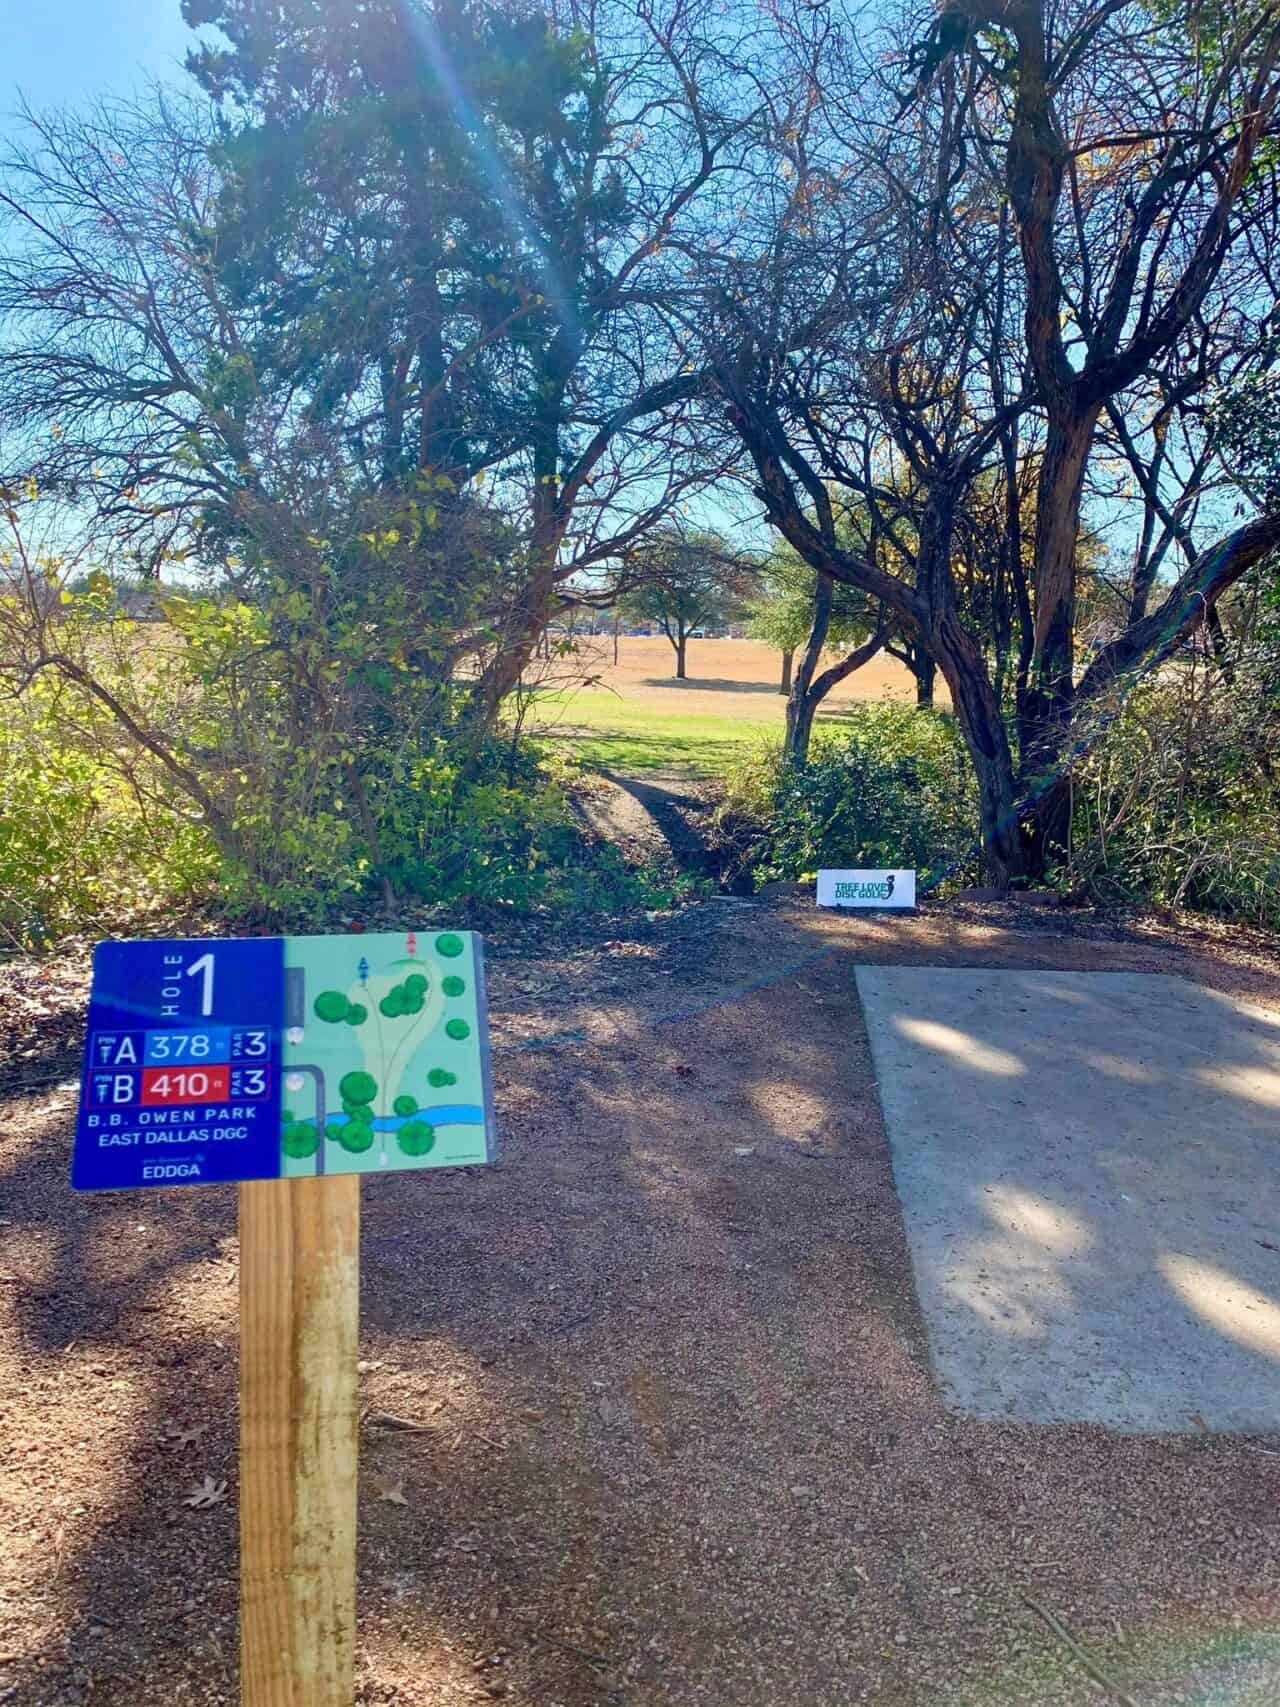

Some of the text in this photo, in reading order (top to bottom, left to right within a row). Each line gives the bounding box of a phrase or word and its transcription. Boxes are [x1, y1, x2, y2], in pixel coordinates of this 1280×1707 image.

[161, 953, 215, 1017] HOLE 1
[114, 1031, 266, 1065] A 378 PAR 3
[113, 1075, 134, 1103] B
[150, 1073, 209, 1097] 410
[243, 1069, 266, 1095] 3
[138, 1110, 196, 1125] OWEN
[205, 1106, 257, 1121] PARK
[98, 1126, 248, 1148] EAST DALLAS DGC
[143, 1163, 201, 1180] EDDGA
